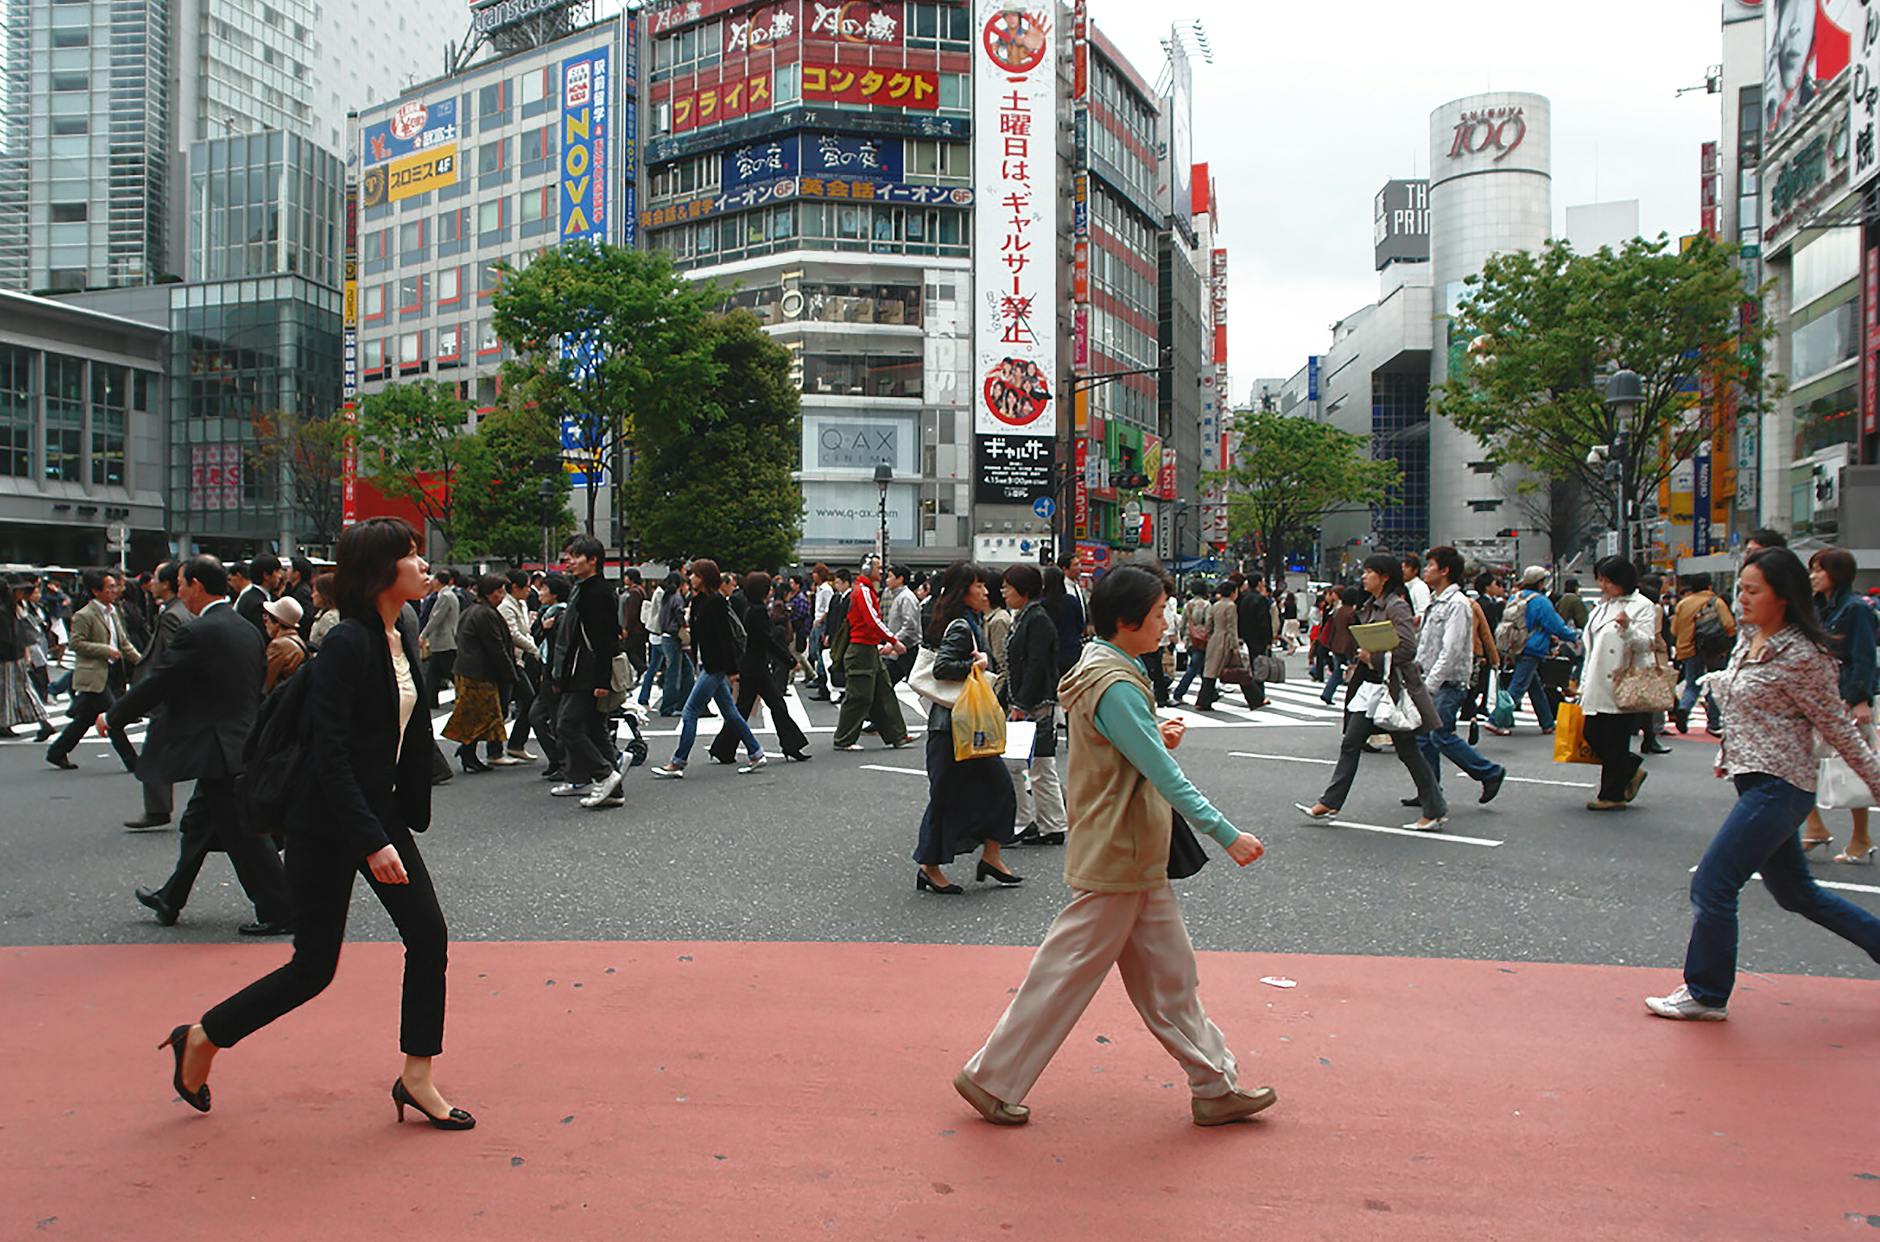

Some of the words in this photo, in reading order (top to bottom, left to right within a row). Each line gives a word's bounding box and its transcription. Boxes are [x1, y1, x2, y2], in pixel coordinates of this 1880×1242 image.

[803, 67, 934, 100] コンタクト
[674, 76, 769, 125] プライス
[1446, 114, 1527, 163] 109
[564, 107, 591, 234] NOVA
[714, 186, 773, 212] イーオン
[800, 178, 875, 200] 英会話
[876, 183, 949, 204] イーオン
[984, 437, 1049, 460] ギャルサー
